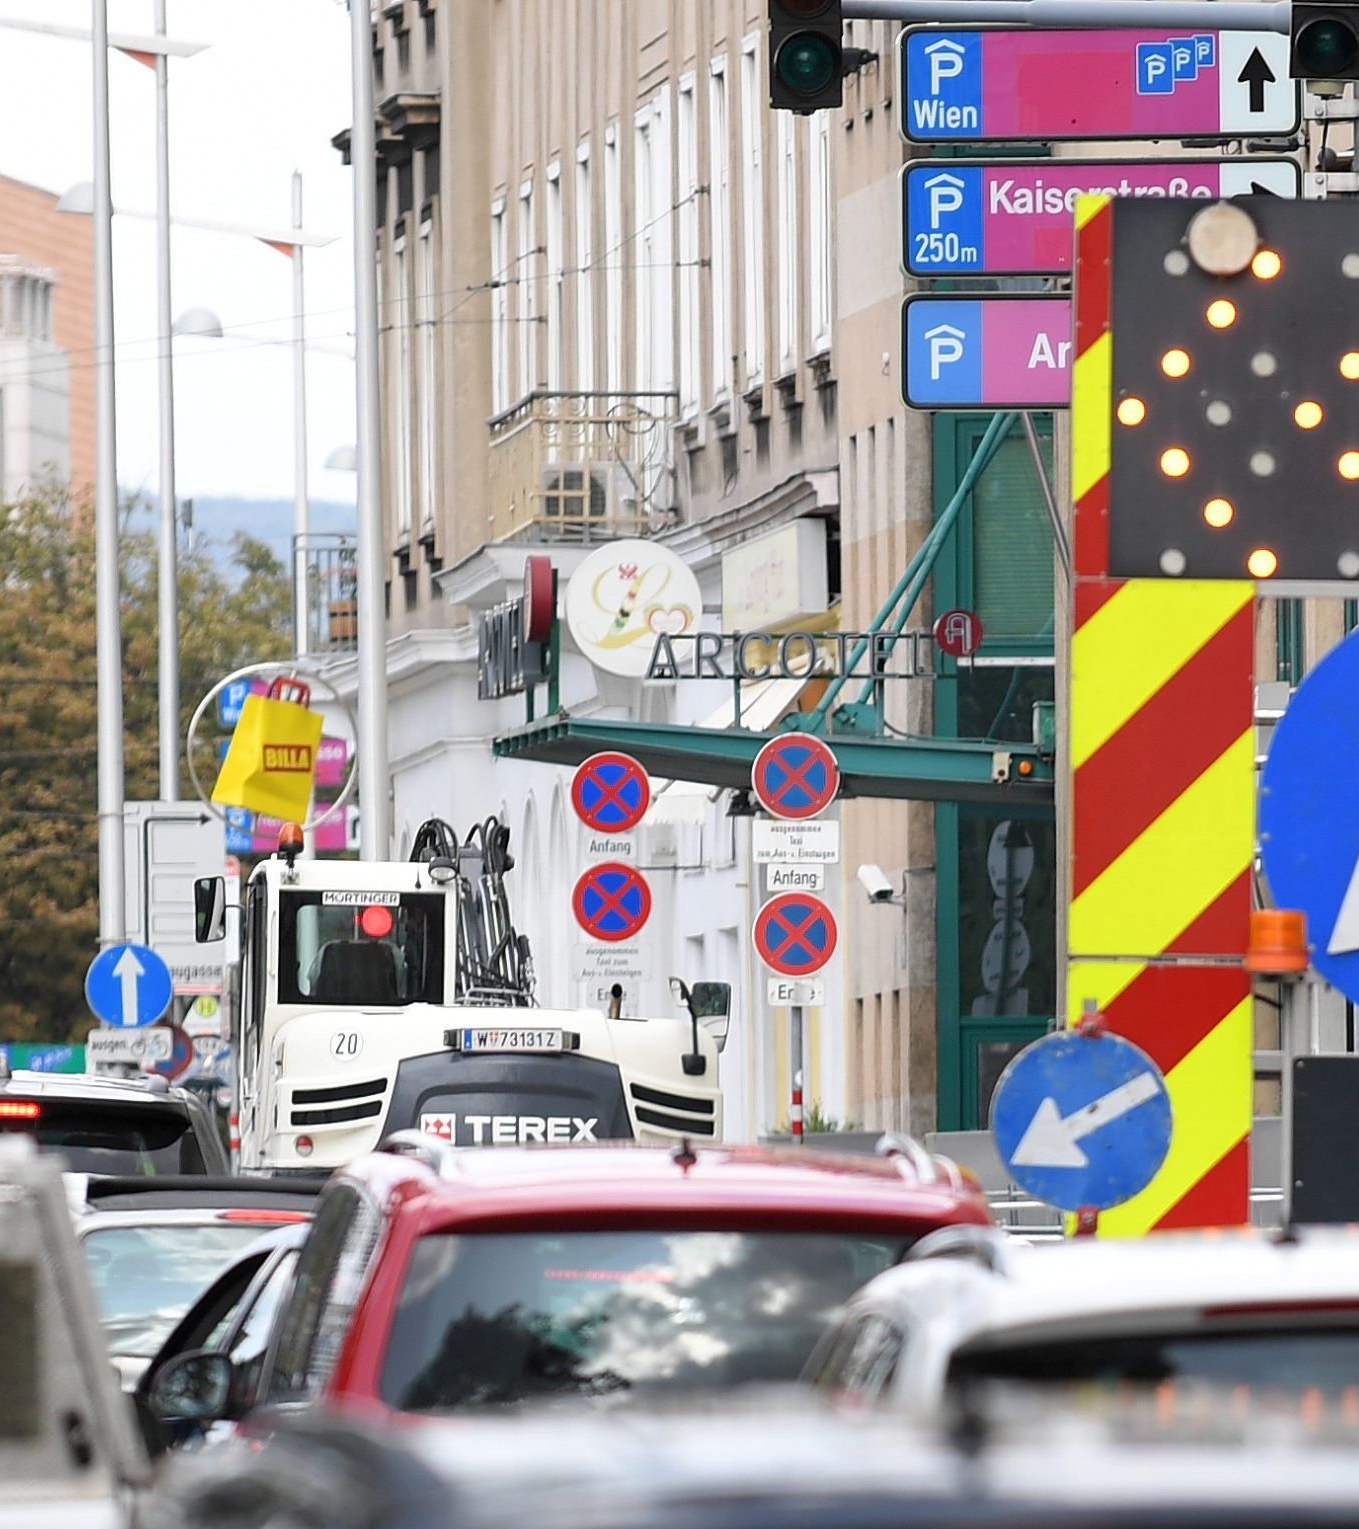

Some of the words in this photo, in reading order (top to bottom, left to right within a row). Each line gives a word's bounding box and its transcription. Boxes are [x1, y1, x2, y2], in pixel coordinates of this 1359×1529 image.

[913, 100, 977, 128] Wien
[644, 630, 937, 681] ARCOTEL
[266, 747, 310, 770] BILLA
[590, 840, 631, 854] Anfang
[773, 870, 817, 887] Anfang
[335, 1034, 357, 1054] 20
[465, 1116, 598, 1142] TEREX
